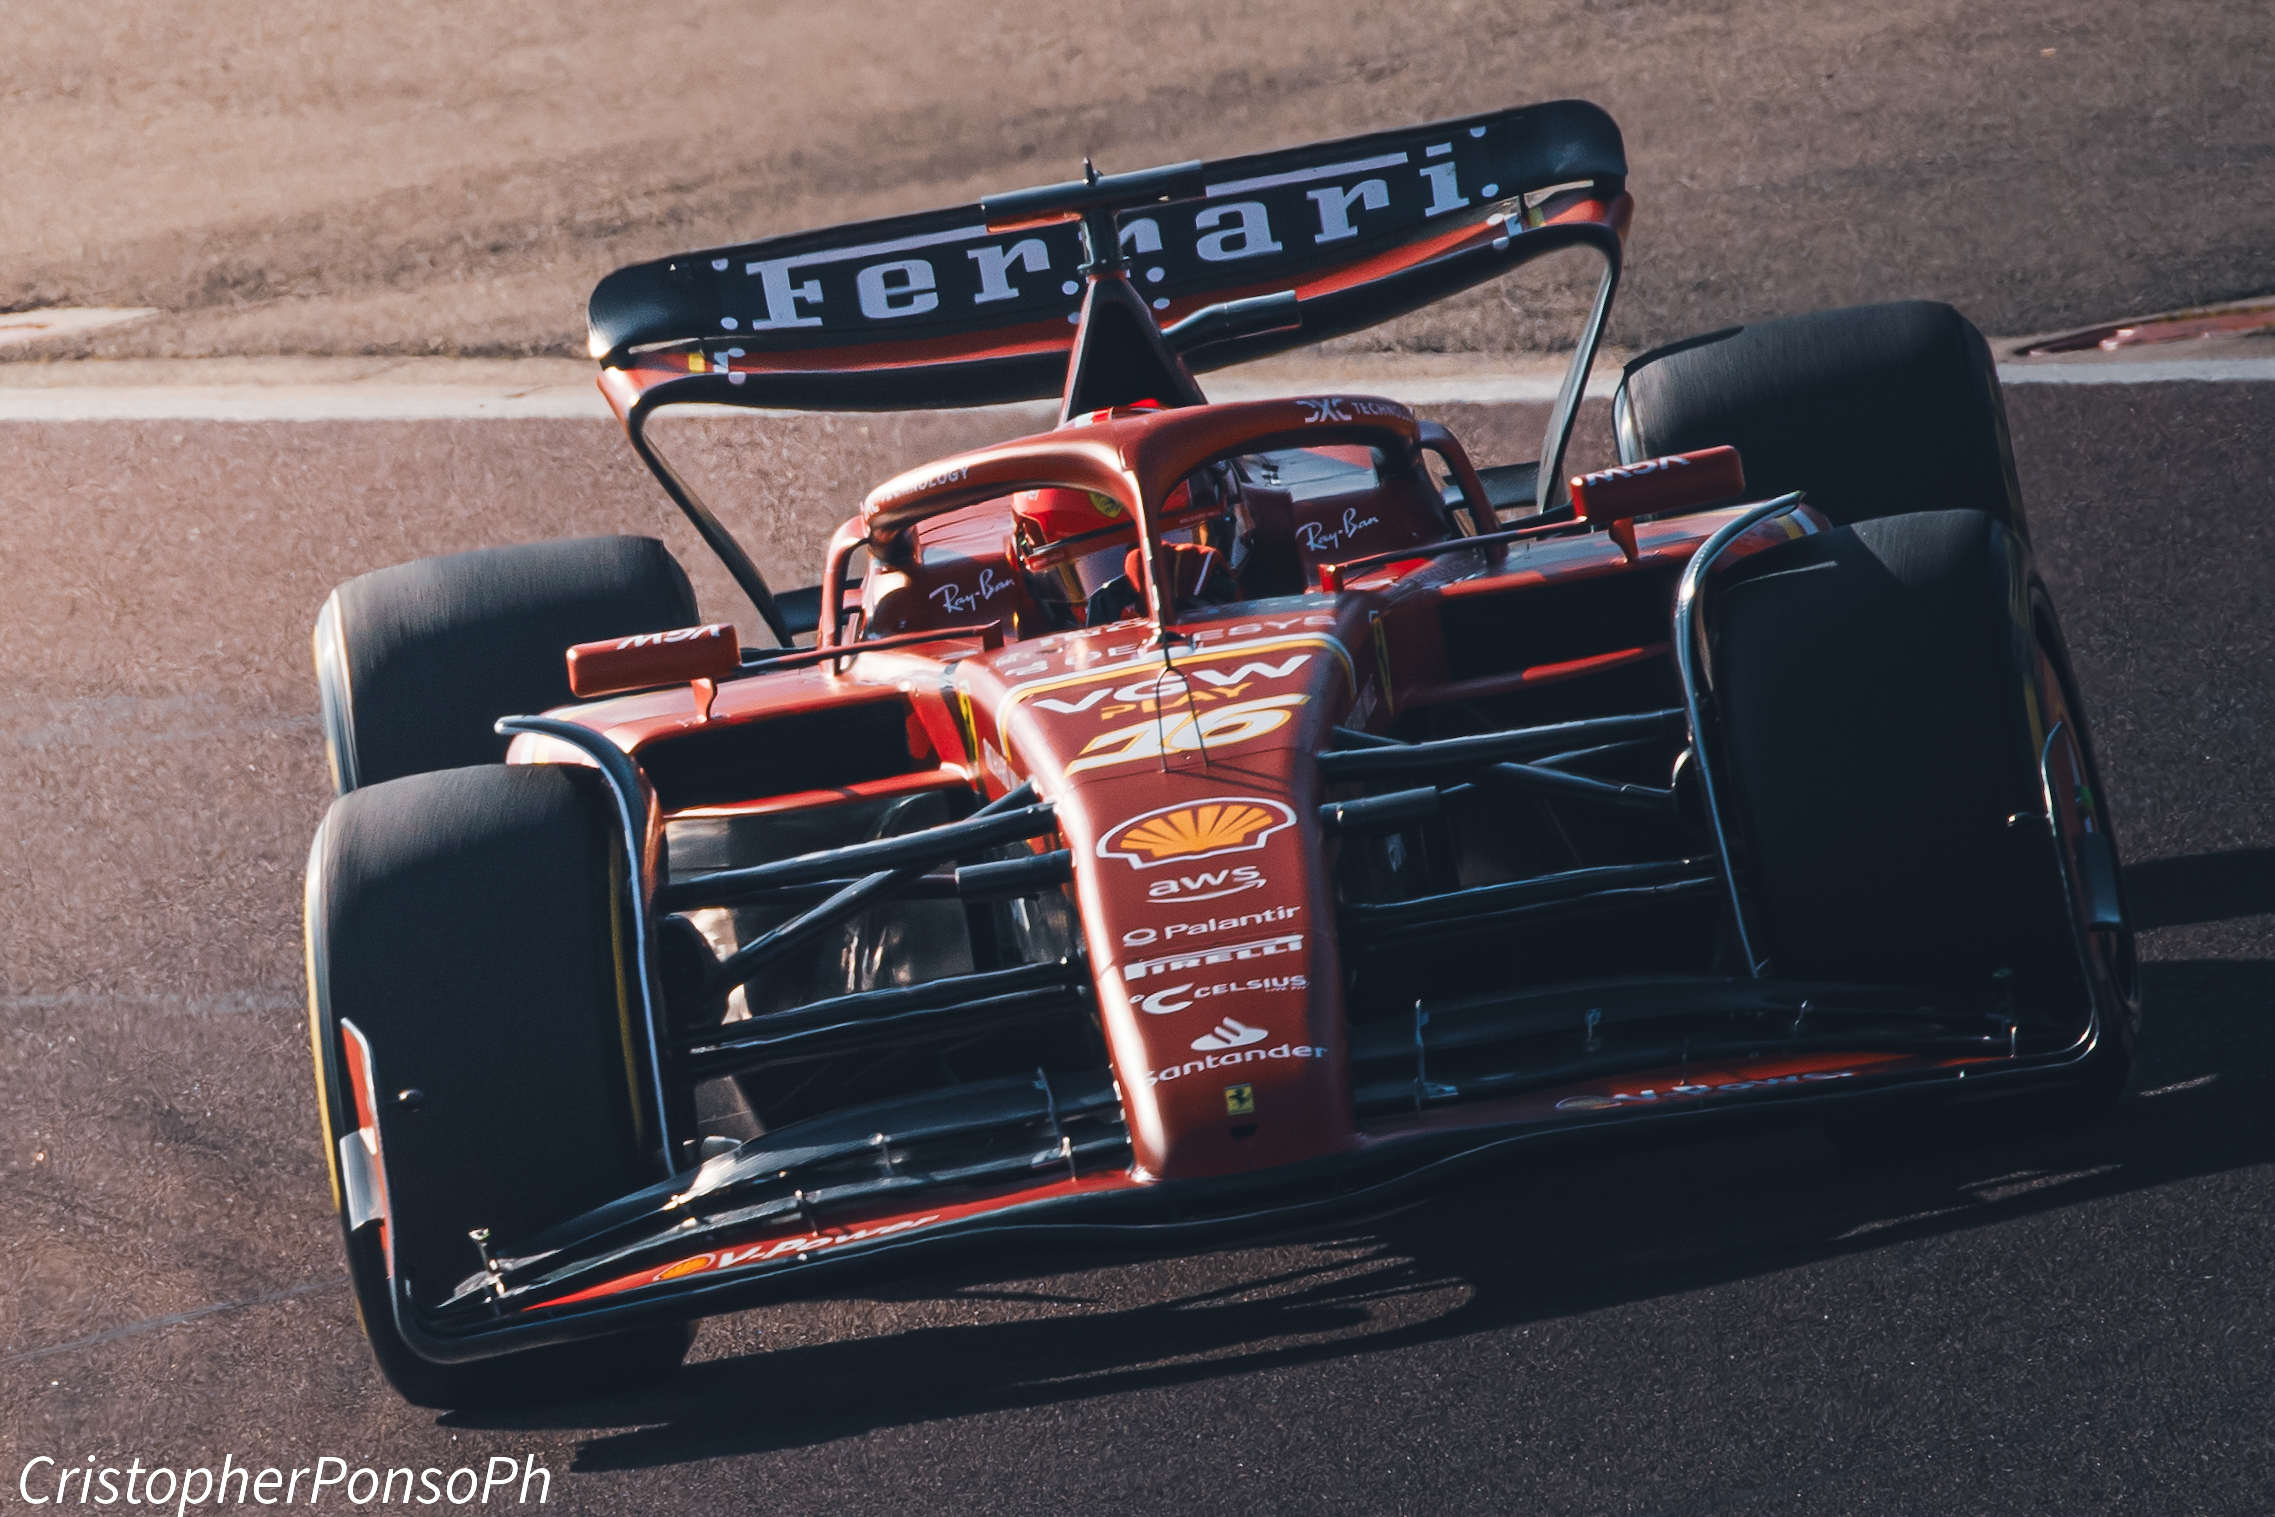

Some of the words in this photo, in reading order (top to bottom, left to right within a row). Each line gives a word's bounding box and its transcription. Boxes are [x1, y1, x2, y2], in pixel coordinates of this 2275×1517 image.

[1296, 508, 1379, 551] Ray-Ban
[929, 568, 1015, 613] Ray-Ban
[1032, 654, 1311, 713] VGW
[1101, 682, 1254, 721] PLAY
[1064, 693, 1311, 778] 16
[1149, 866, 1261, 897] aws
[1164, 906, 1301, 940] Palantir
[1124, 934, 1304, 981] PIRELLI
[1194, 974, 1308, 999] CELSIUS
[1141, 1043, 1328, 1088] Santander
